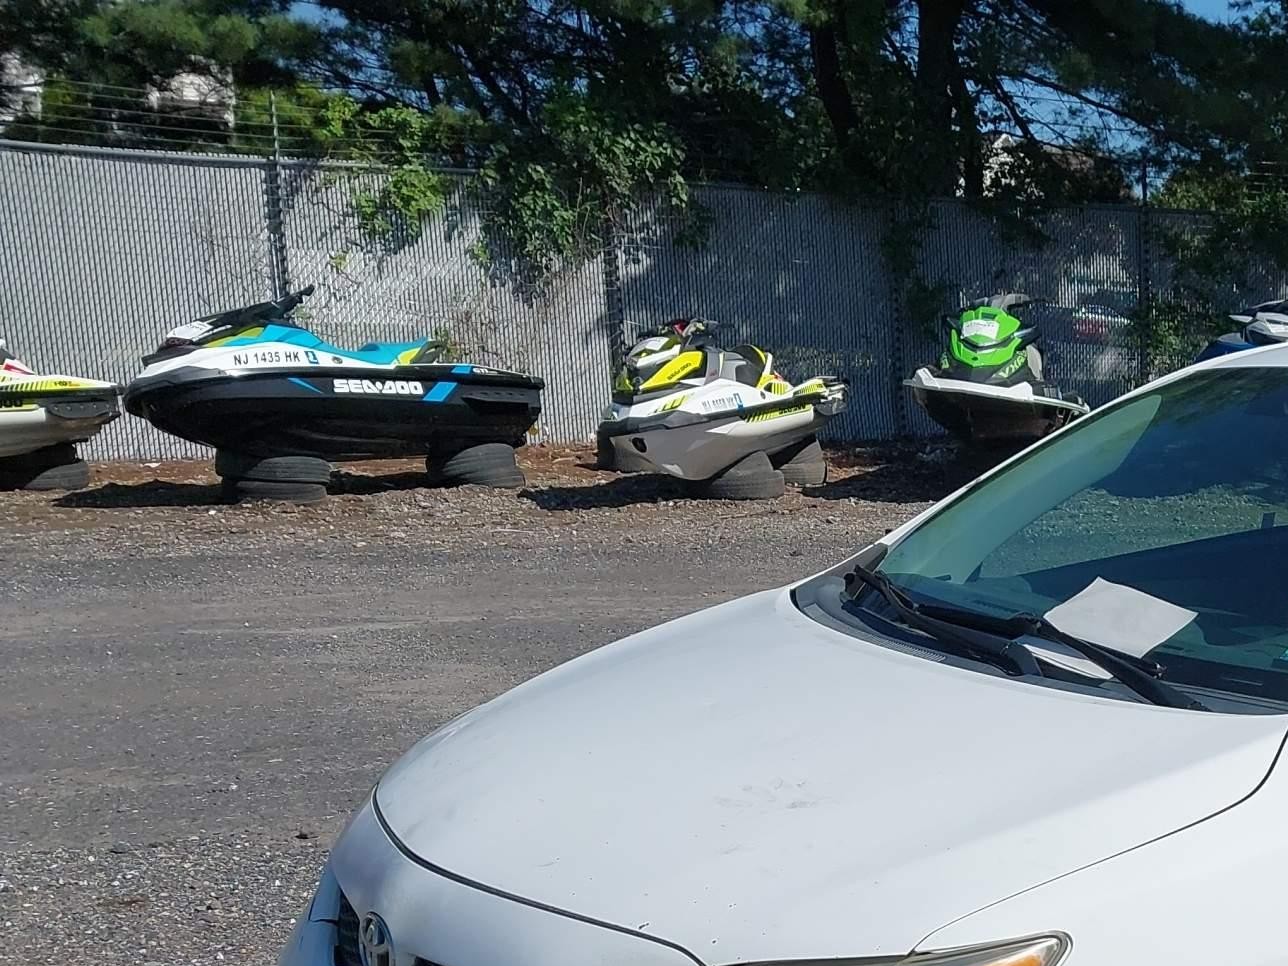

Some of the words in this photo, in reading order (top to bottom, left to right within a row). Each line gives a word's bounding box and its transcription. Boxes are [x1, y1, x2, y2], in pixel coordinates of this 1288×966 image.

[233, 353, 249, 365] NJ
[253, 351, 281, 364] 1435
[285, 350, 301, 363] HK
